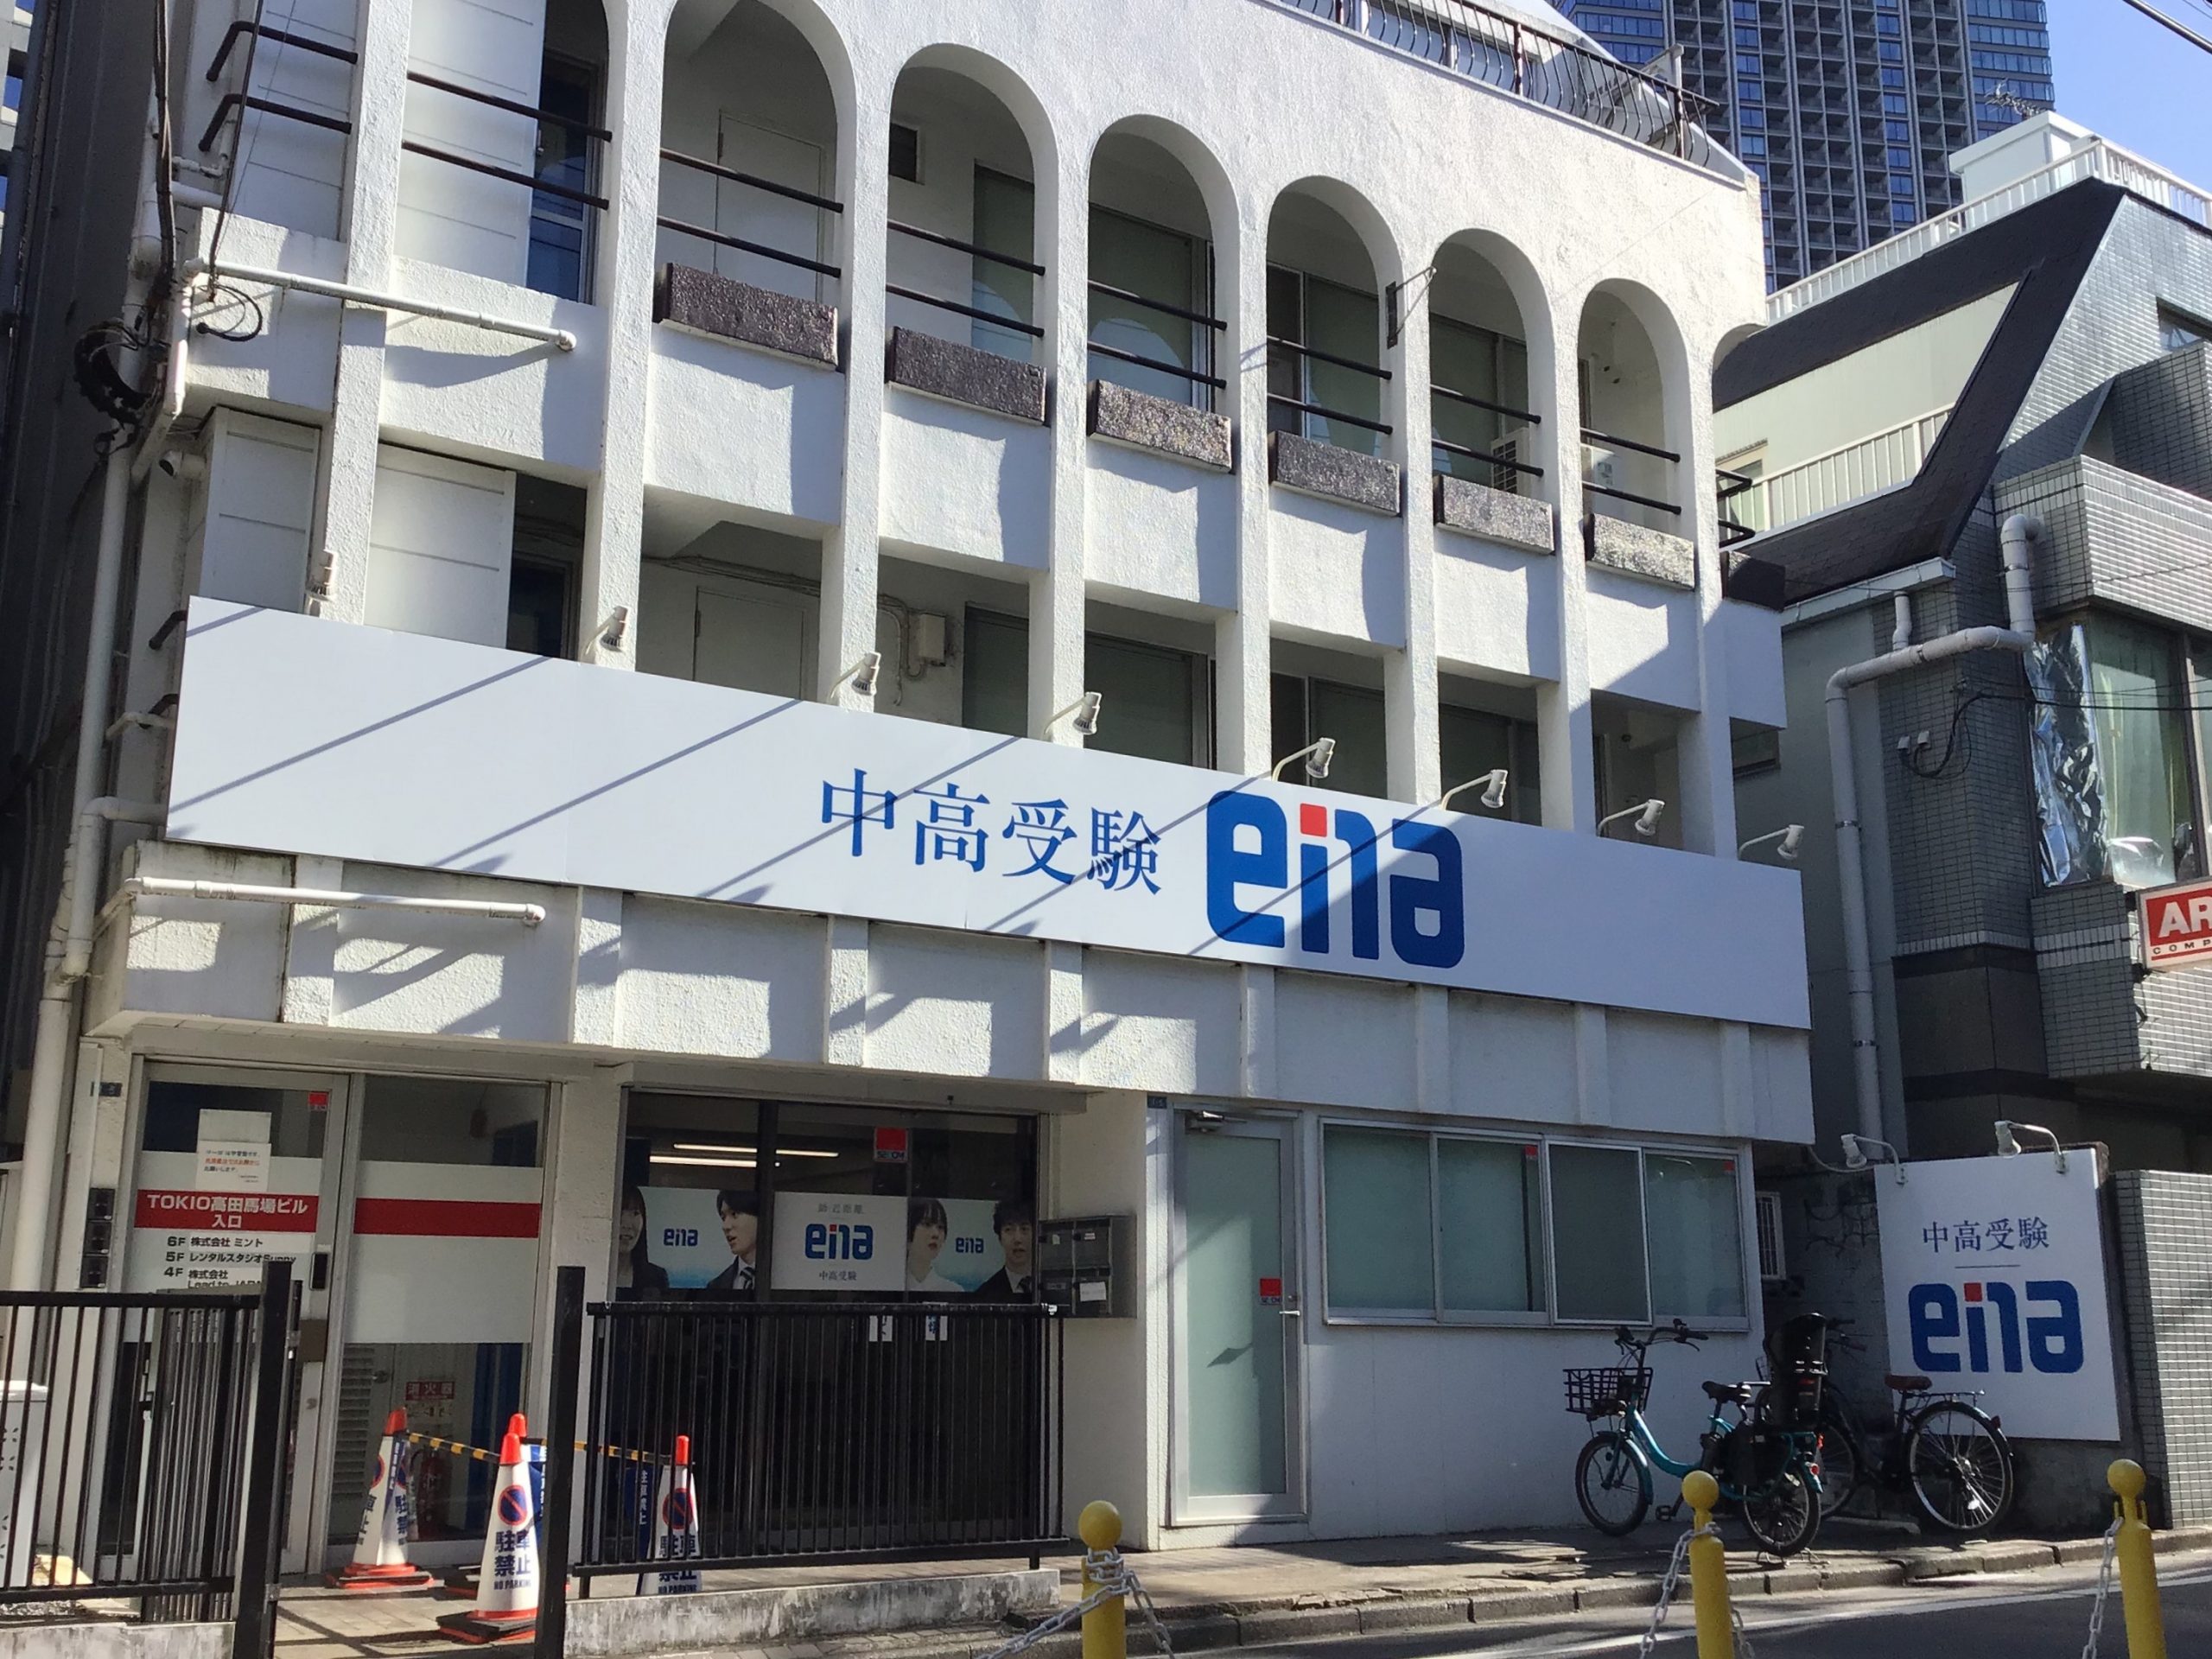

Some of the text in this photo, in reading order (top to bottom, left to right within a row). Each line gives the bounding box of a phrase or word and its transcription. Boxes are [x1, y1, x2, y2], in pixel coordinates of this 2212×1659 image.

[822, 767, 1465, 968] 中高受験 ena
[147, 1194, 308, 1215] TOKIO高田馬場ビル
[212, 1214, 242, 1228] 入口
[167, 1236, 264, 1247] 6F 株式会社 ミント
[664, 1228, 698, 1247] ena
[805, 1224, 874, 1260] ena
[956, 1237, 984, 1254] ena
[1923, 1217, 2050, 1254] 中高受験
[165, 1251, 184, 1262] 5F
[163, 1267, 228, 1280] 4F 株式会社
[1908, 1280, 2084, 1374] ena
[494, 1529, 531, 1553] 駐車
[494, 1554, 531, 1577] 禁止
